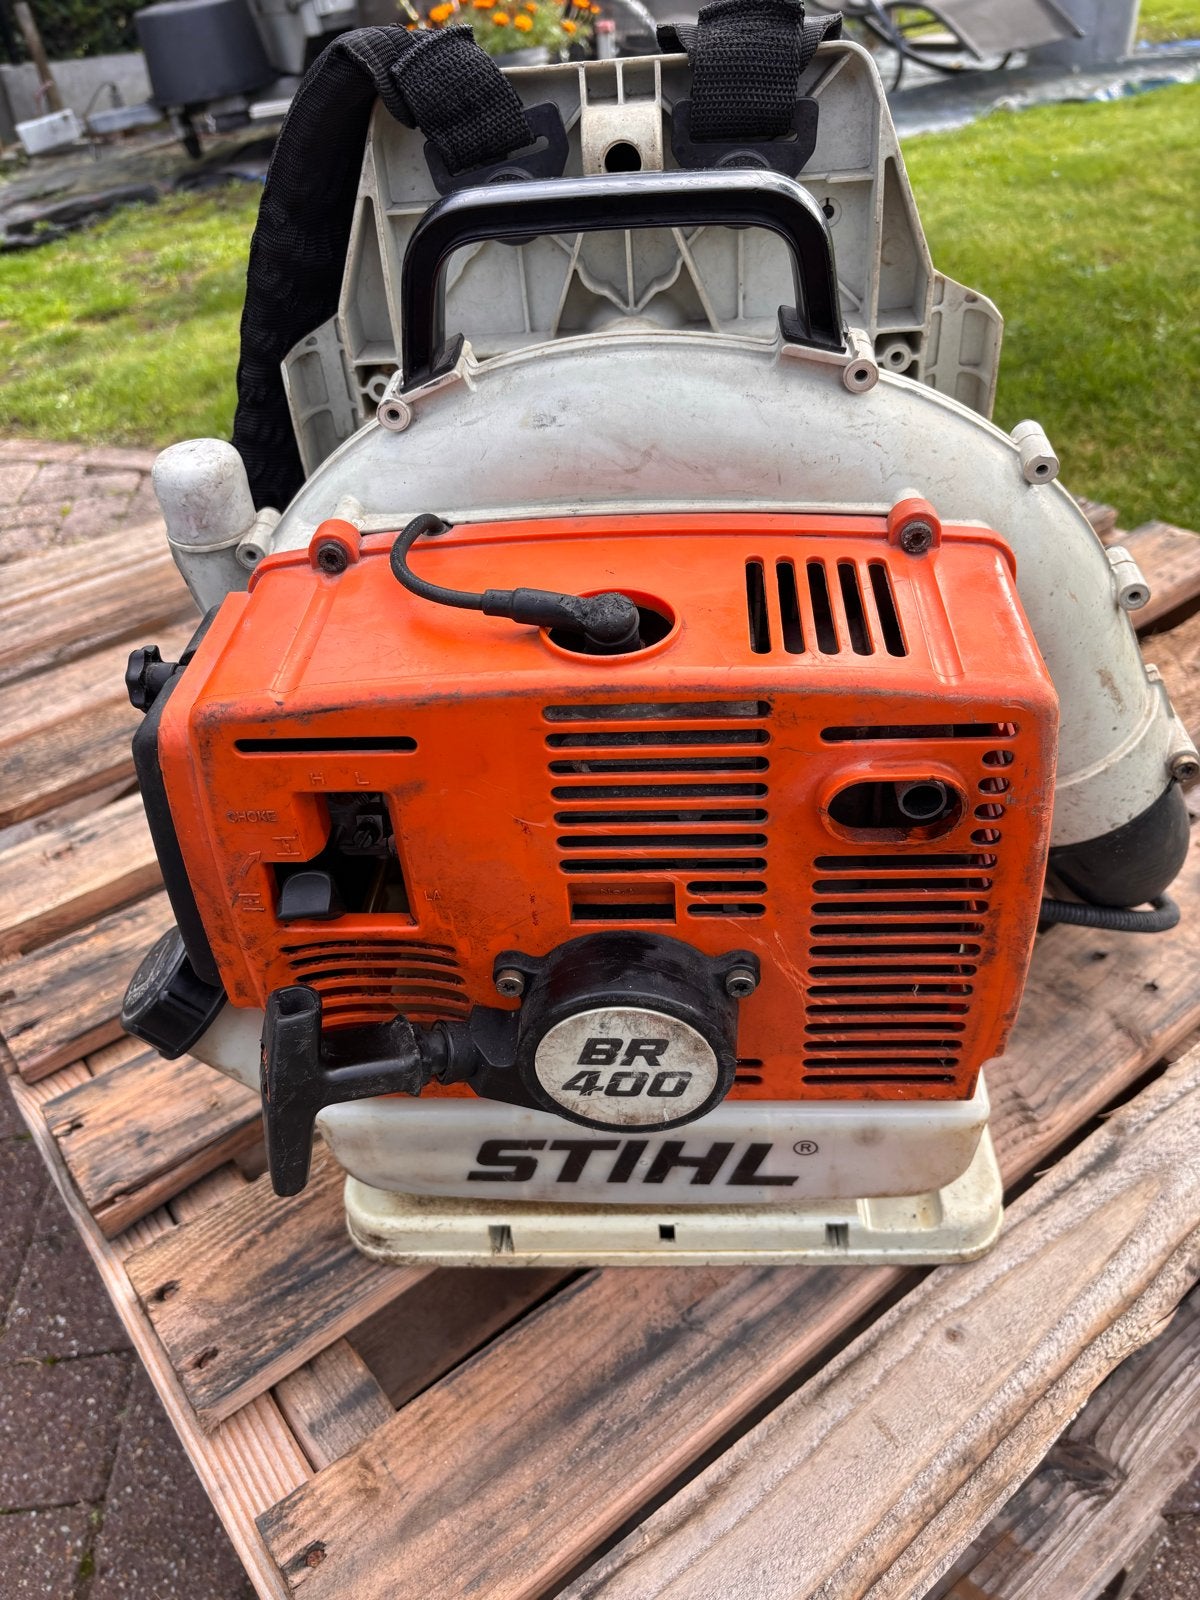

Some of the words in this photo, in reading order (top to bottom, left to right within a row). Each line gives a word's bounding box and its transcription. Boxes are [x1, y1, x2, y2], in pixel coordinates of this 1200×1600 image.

[310, 772, 325, 785] H
[226, 810, 278, 824] CHOKE
[423, 889, 441, 901] LA
[577, 1037, 670, 1067] BR
[561, 1070, 693, 1098] 400
[467, 1139, 799, 1186] STIHL
